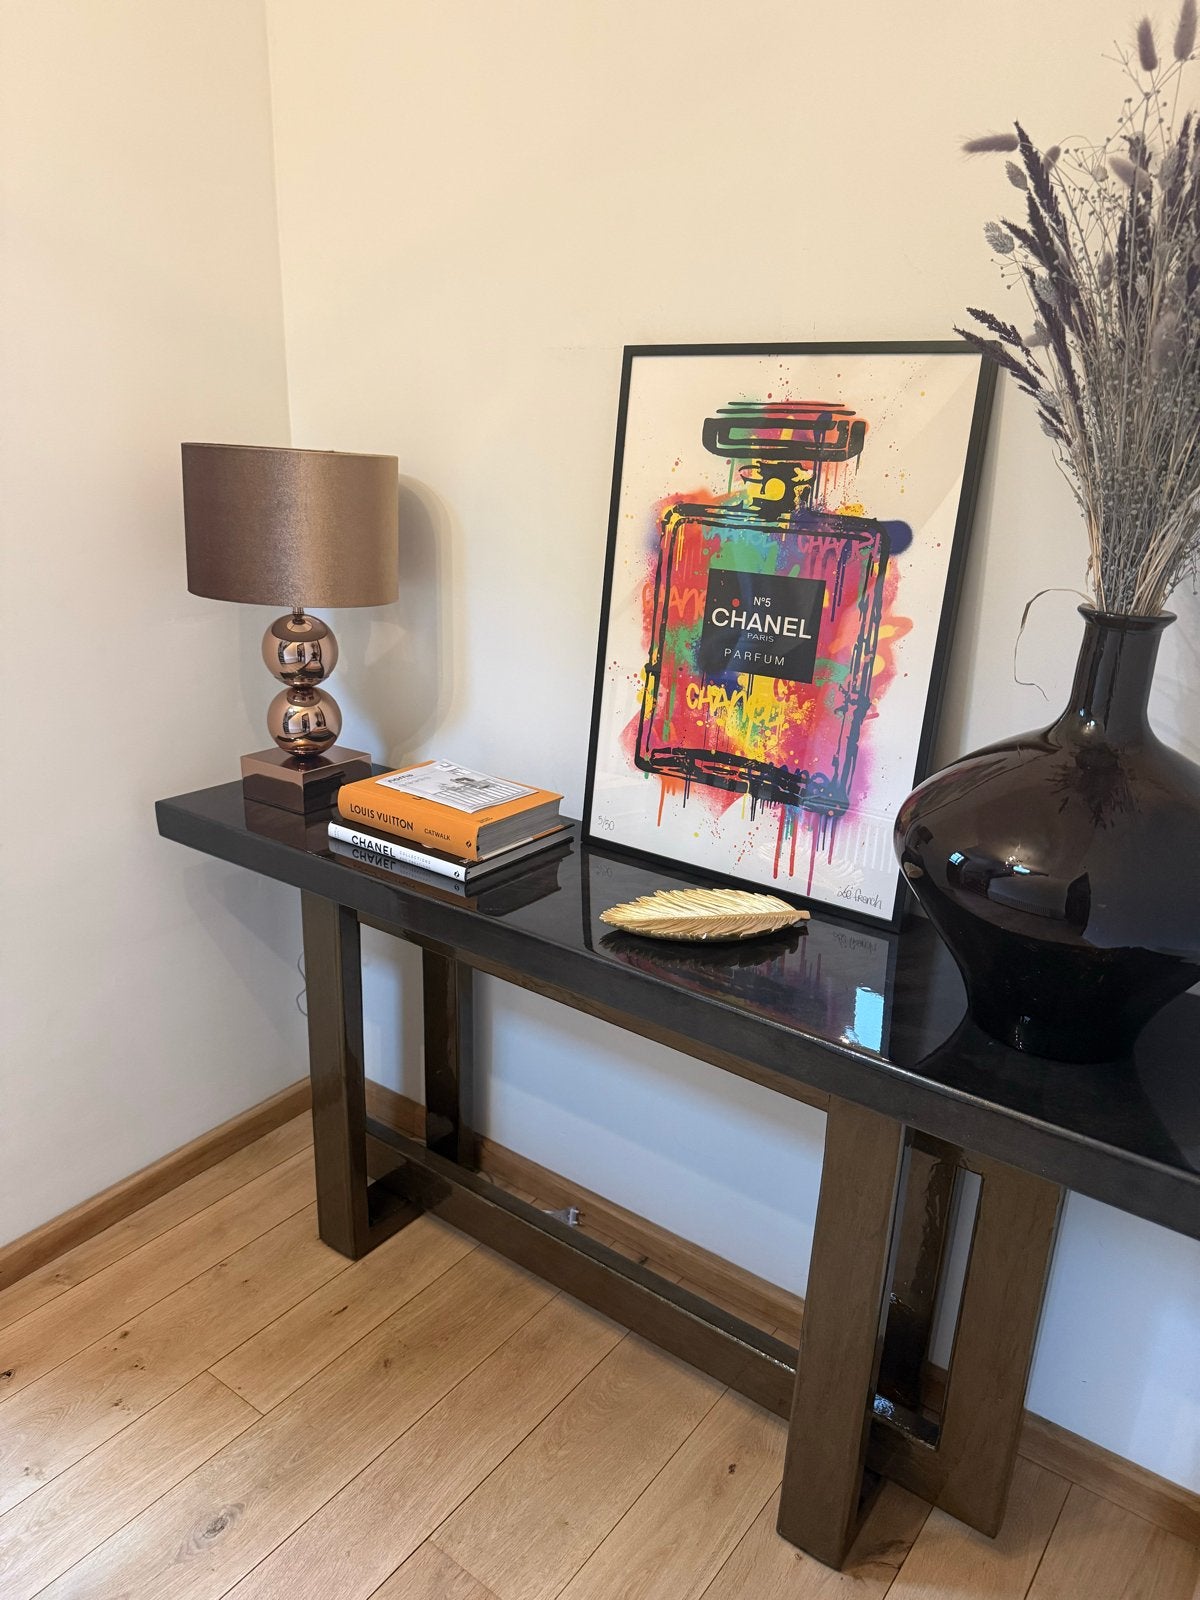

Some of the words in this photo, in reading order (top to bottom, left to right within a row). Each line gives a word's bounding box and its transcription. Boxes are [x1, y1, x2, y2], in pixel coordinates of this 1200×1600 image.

[711, 607, 812, 639] CHANEL
[747, 632, 774, 643] PARIS
[724, 648, 786, 666] PARFUM
[350, 803, 375, 819] LOUIS
[376, 811, 414, 832] VUITTON
[424, 828, 451, 841] CATWALK
[351, 835, 396, 858] CHANEL
